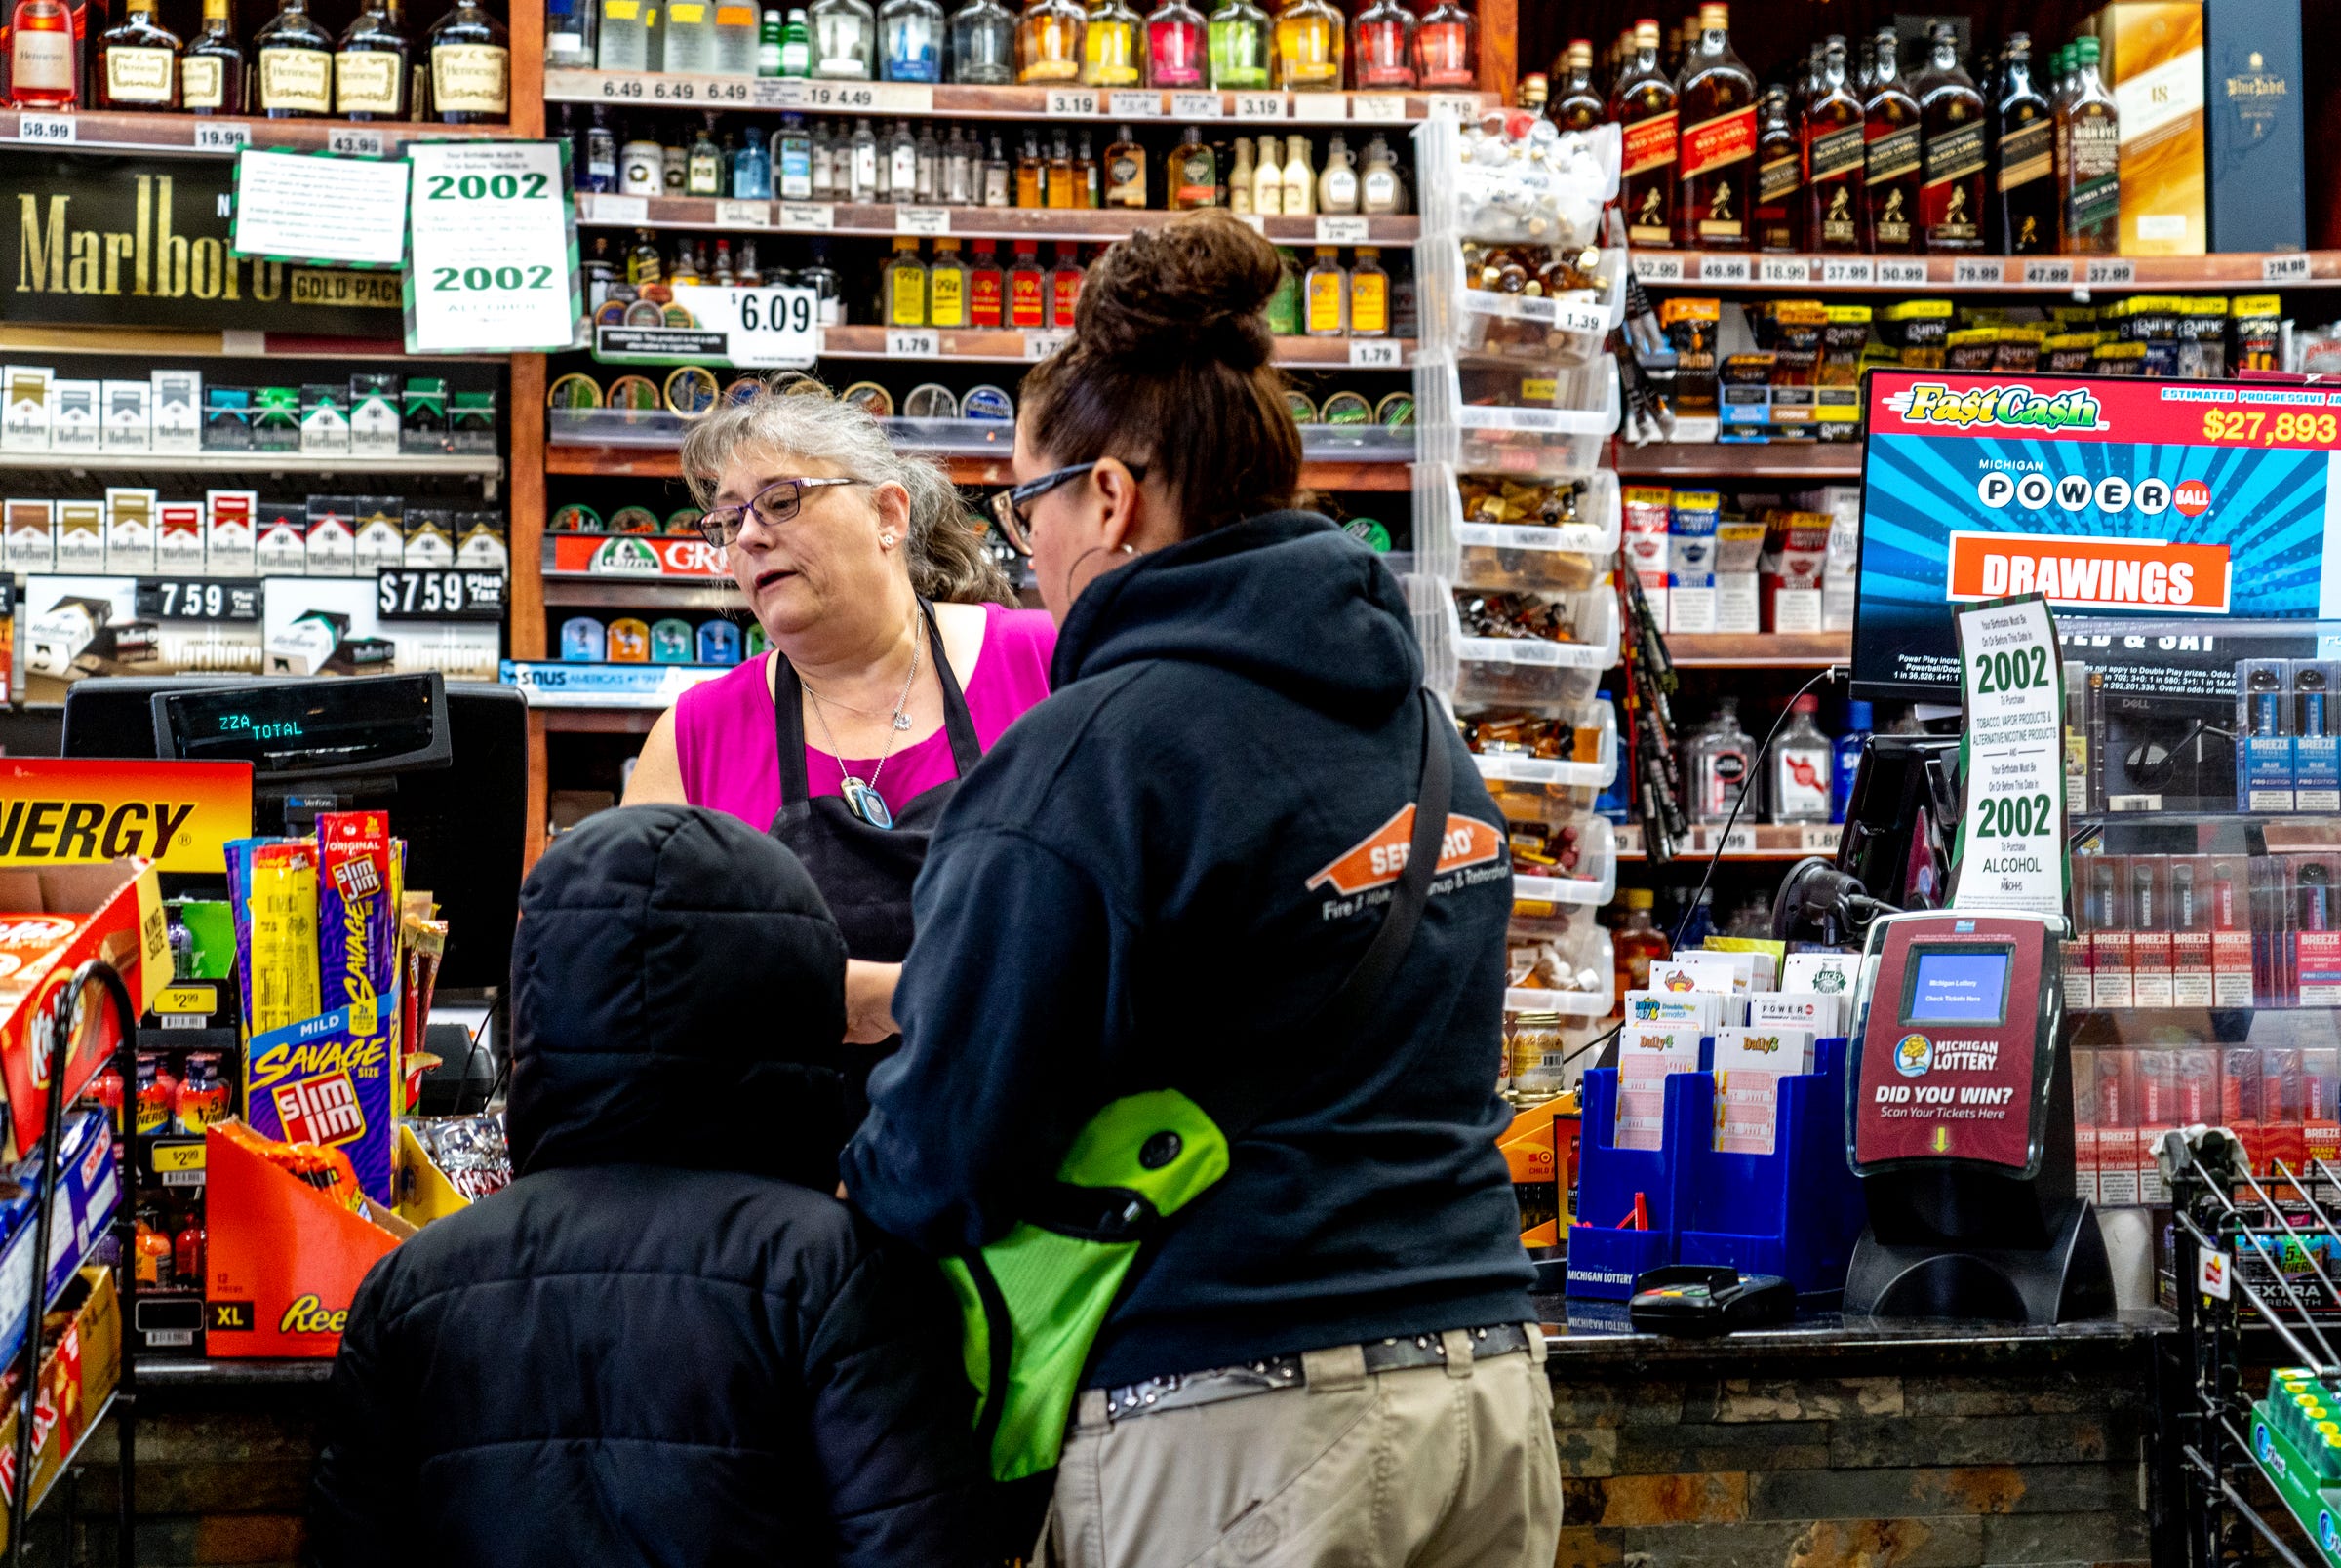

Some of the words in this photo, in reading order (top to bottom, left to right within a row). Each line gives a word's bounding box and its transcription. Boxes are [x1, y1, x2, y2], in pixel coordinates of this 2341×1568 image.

[604, 82, 642, 98] 6.49
[655, 83, 693, 98] 6.49
[708, 84, 746, 99] 6.49
[839, 90, 872, 105] 4.49
[1054, 98, 1092, 113] 3.19
[1245, 100, 1277, 115] 3.19
[23, 122, 69, 137] 58.99
[200, 131, 244, 145] 19.99
[334, 137, 378, 152] 43.99
[427, 173, 549, 200] 2002
[432, 265, 554, 291] 2002
[1637, 263, 1678, 278] 32.99
[1766, 266, 1805, 280] 18.99
[1828, 265, 1868, 279] 37.99
[1882, 267, 1923, 281] 50.99
[2028, 268, 2069, 283] 47.99
[297, 274, 347, 300] GOLD
[1567, 313, 1600, 330] 1.39
[897, 338, 930, 352] 1.79
[1360, 348, 1391, 363] 1.79
[2162, 388, 2235, 402] ESTIMATED
[2240, 390, 2324, 404] PROGRESSIVE
[2202, 406, 2337, 447] $27,893
[1979, 458, 2043, 472] MICHIGAN
[1982, 554, 2194, 605] DRAWINGS
[160, 582, 223, 616] 7.59
[379, 572, 463, 613] $7.59
[466, 573, 503, 589] Plus
[470, 587, 500, 602] Tax
[1898, 654, 1921, 664] Power
[1923, 655, 1939, 666] Play
[1905, 663, 1962, 673] Powerball/Doub
[1975, 645, 2050, 695] 2002
[2109, 665, 2128, 675] apply
[2139, 667, 2164, 676] Double
[2166, 668, 2183, 678] Play
[2184, 669, 2208, 680] prizes.
[2210, 670, 2231, 680] Odds
[521, 670, 567, 685] snus
[2159, 685, 2185, 693] Overall
[2187, 686, 2204, 694] odds
[2205, 686, 2214, 695] of
[2005, 695, 2026, 706] Purchase
[2122, 698, 2151, 710] DELL
[219, 715, 251, 731] ZZA
[2001, 714, 2018, 727] VAPOR
[2018, 712, 2046, 725] PRODUCTS
[252, 722, 303, 740] TOTAL
[1972, 730, 2004, 747] ALTERNATIVE
[2004, 729, 2027, 744] NICOTINE
[2027, 727, 2057, 743] PRODUCTS
[2250, 738, 2289, 750] BREEZE
[2297, 738, 2337, 750] BREEZE
[1976, 793, 2051, 838] 2002
[329, 841, 380, 851] ORIGINAL
[1369, 827, 1472, 876] SERRO
[2006, 842, 2026, 852] Purchase
[1982, 857, 2043, 873] ALCOHOL
[1322, 899, 1353, 921] Fire
[2093, 934, 2131, 944] BREEZE
[2134, 934, 2171, 944] BREEZE
[2174, 934, 2210, 944] BREEZE
[2214, 933, 2251, 944] BREEZE
[2300, 933, 2340, 945] BREEZE
[343, 902, 377, 1005] SAVAGE
[1815, 970, 1845, 983] Lucky
[1928, 979, 1955, 988] Michigan
[1955, 979, 1977, 988] Lottery
[299, 1015, 340, 1037] MILD
[1934, 1040, 1999, 1054] MICHIGAN
[250, 1036, 387, 1092] SAVAGE
[1933, 1054, 1998, 1071] LOTTERY
[357, 1066, 380, 1078] SIZE
[1875, 1085, 1911, 1104] DID
[1914, 1086, 1955, 1104] YOU
[1960, 1087, 2014, 1105] WIN?
[1881, 1106, 1908, 1118] Scan
[1910, 1106, 1935, 1118] Your
[1937, 1107, 1976, 1119] Tickets
[1979, 1108, 2005, 1120] Here
[2099, 1131, 2136, 1142] BREEZE
[2304, 1127, 2340, 1139] BREEZE
[1567, 1269, 1603, 1283] MICHIGAN
[1603, 1270, 1633, 1286] LOTTERY
[2249, 1284, 2321, 1298] EXTRA
[217, 1306, 244, 1326] XL
[280, 1294, 348, 1333] Ree
